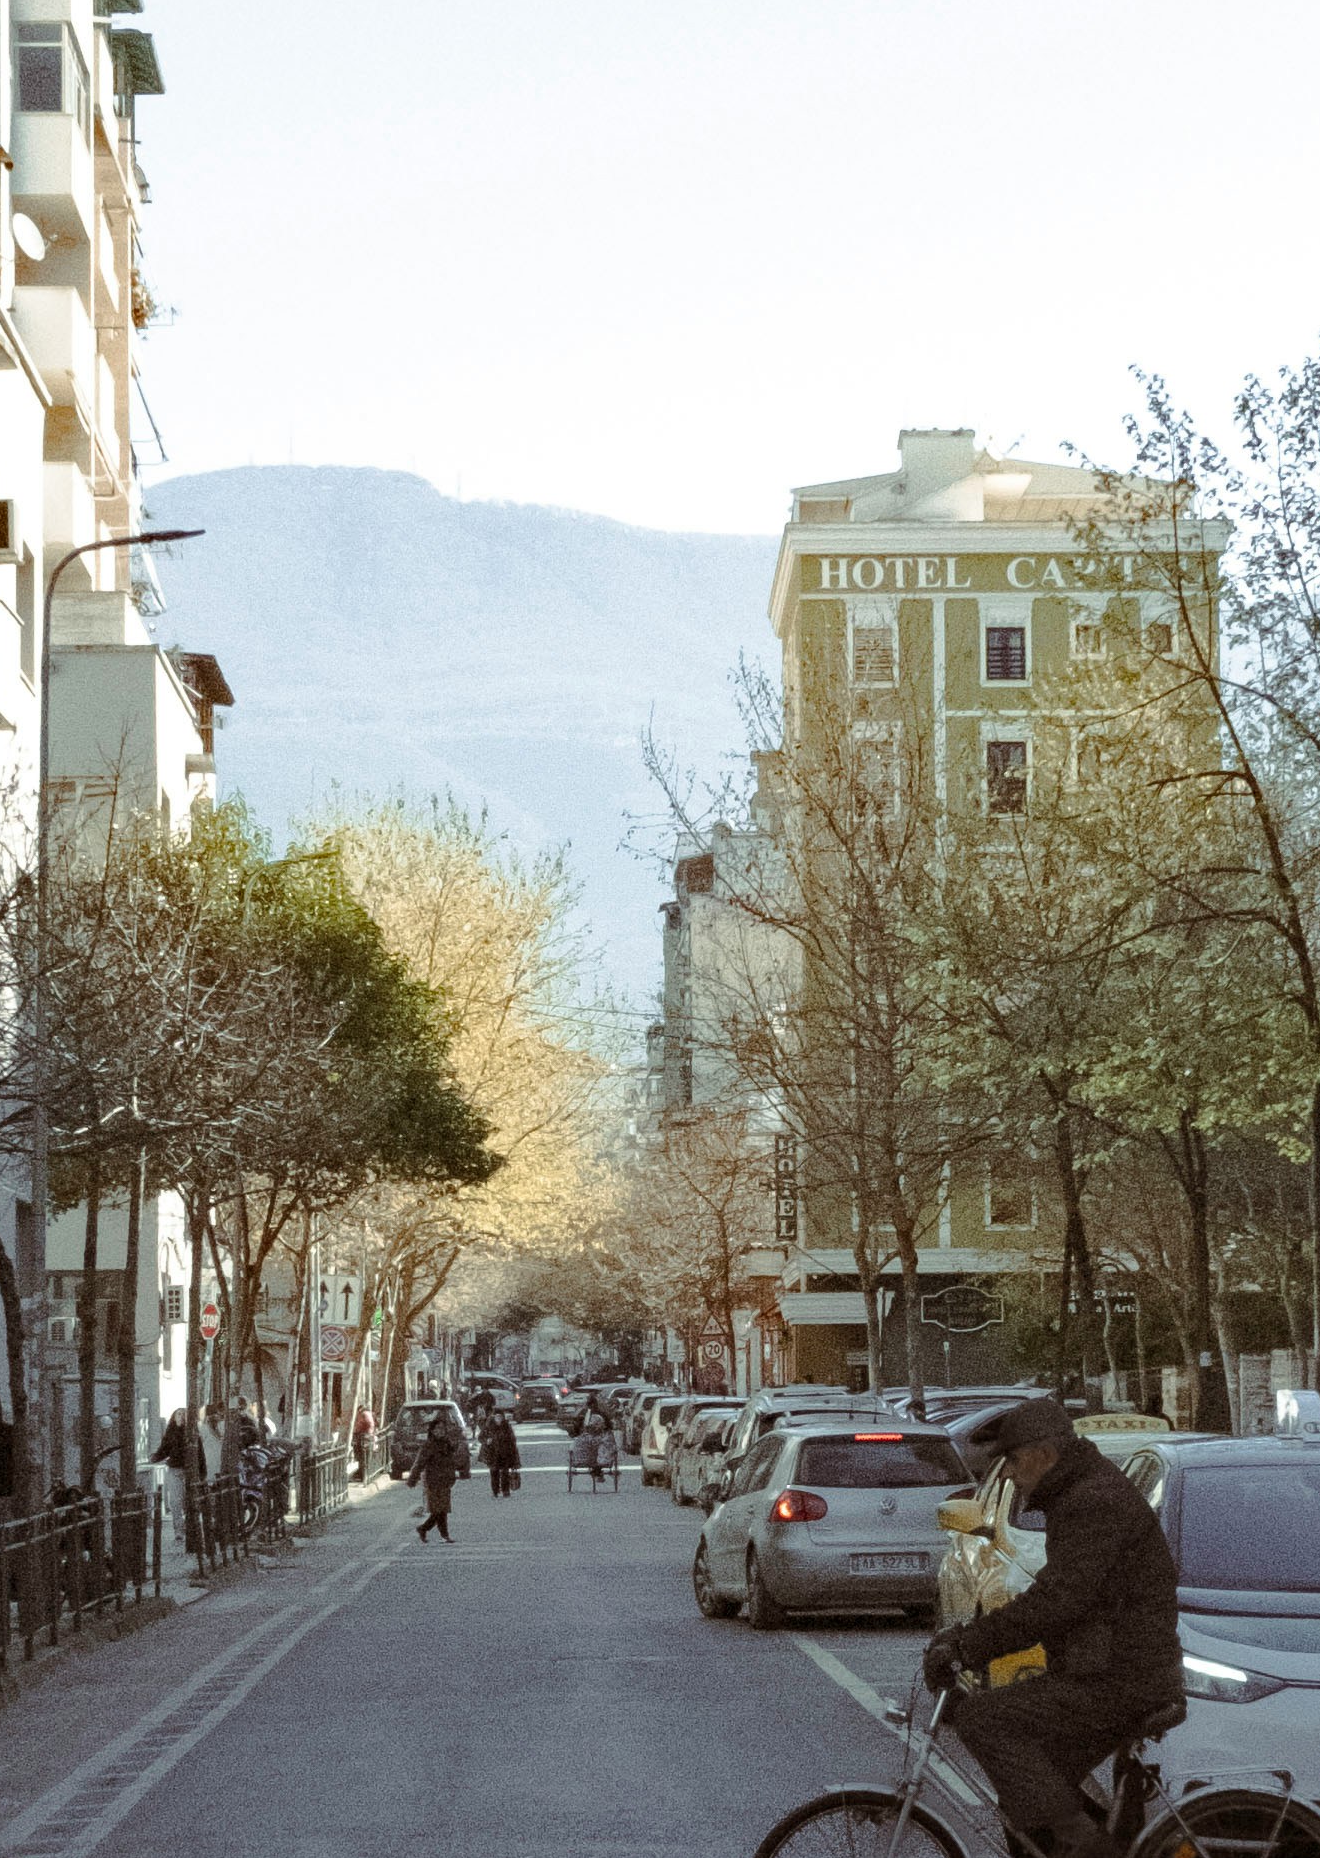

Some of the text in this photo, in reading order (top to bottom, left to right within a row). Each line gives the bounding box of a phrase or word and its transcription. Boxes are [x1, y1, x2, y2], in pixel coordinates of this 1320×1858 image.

[820, 558, 971, 589] HOTEL
[201, 1313, 220, 1328] STOP
[708, 1344, 721, 1355] 20
[1092, 1419, 1147, 1430] TAXI
